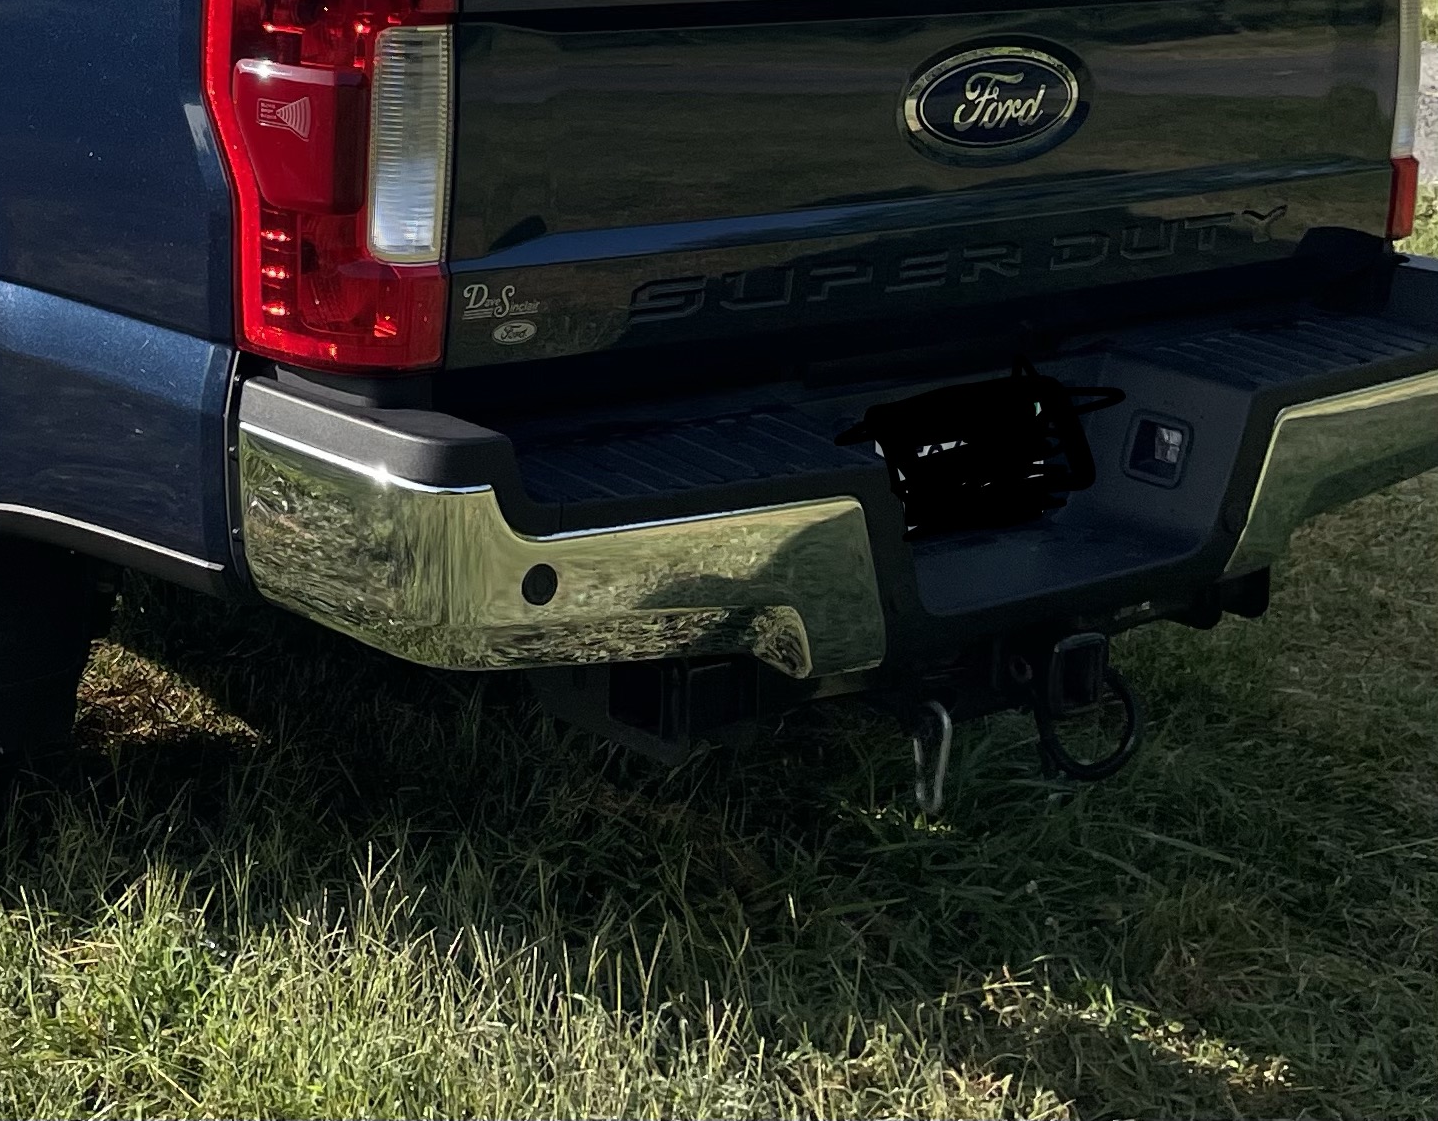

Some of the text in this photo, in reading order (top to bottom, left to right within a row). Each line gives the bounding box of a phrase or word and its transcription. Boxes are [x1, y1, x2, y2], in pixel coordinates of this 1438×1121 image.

[953, 71, 1047, 132] Ford
[628, 205, 1289, 325] SUPER DUTY
[463, 283, 541, 318] Dave Sinclair
